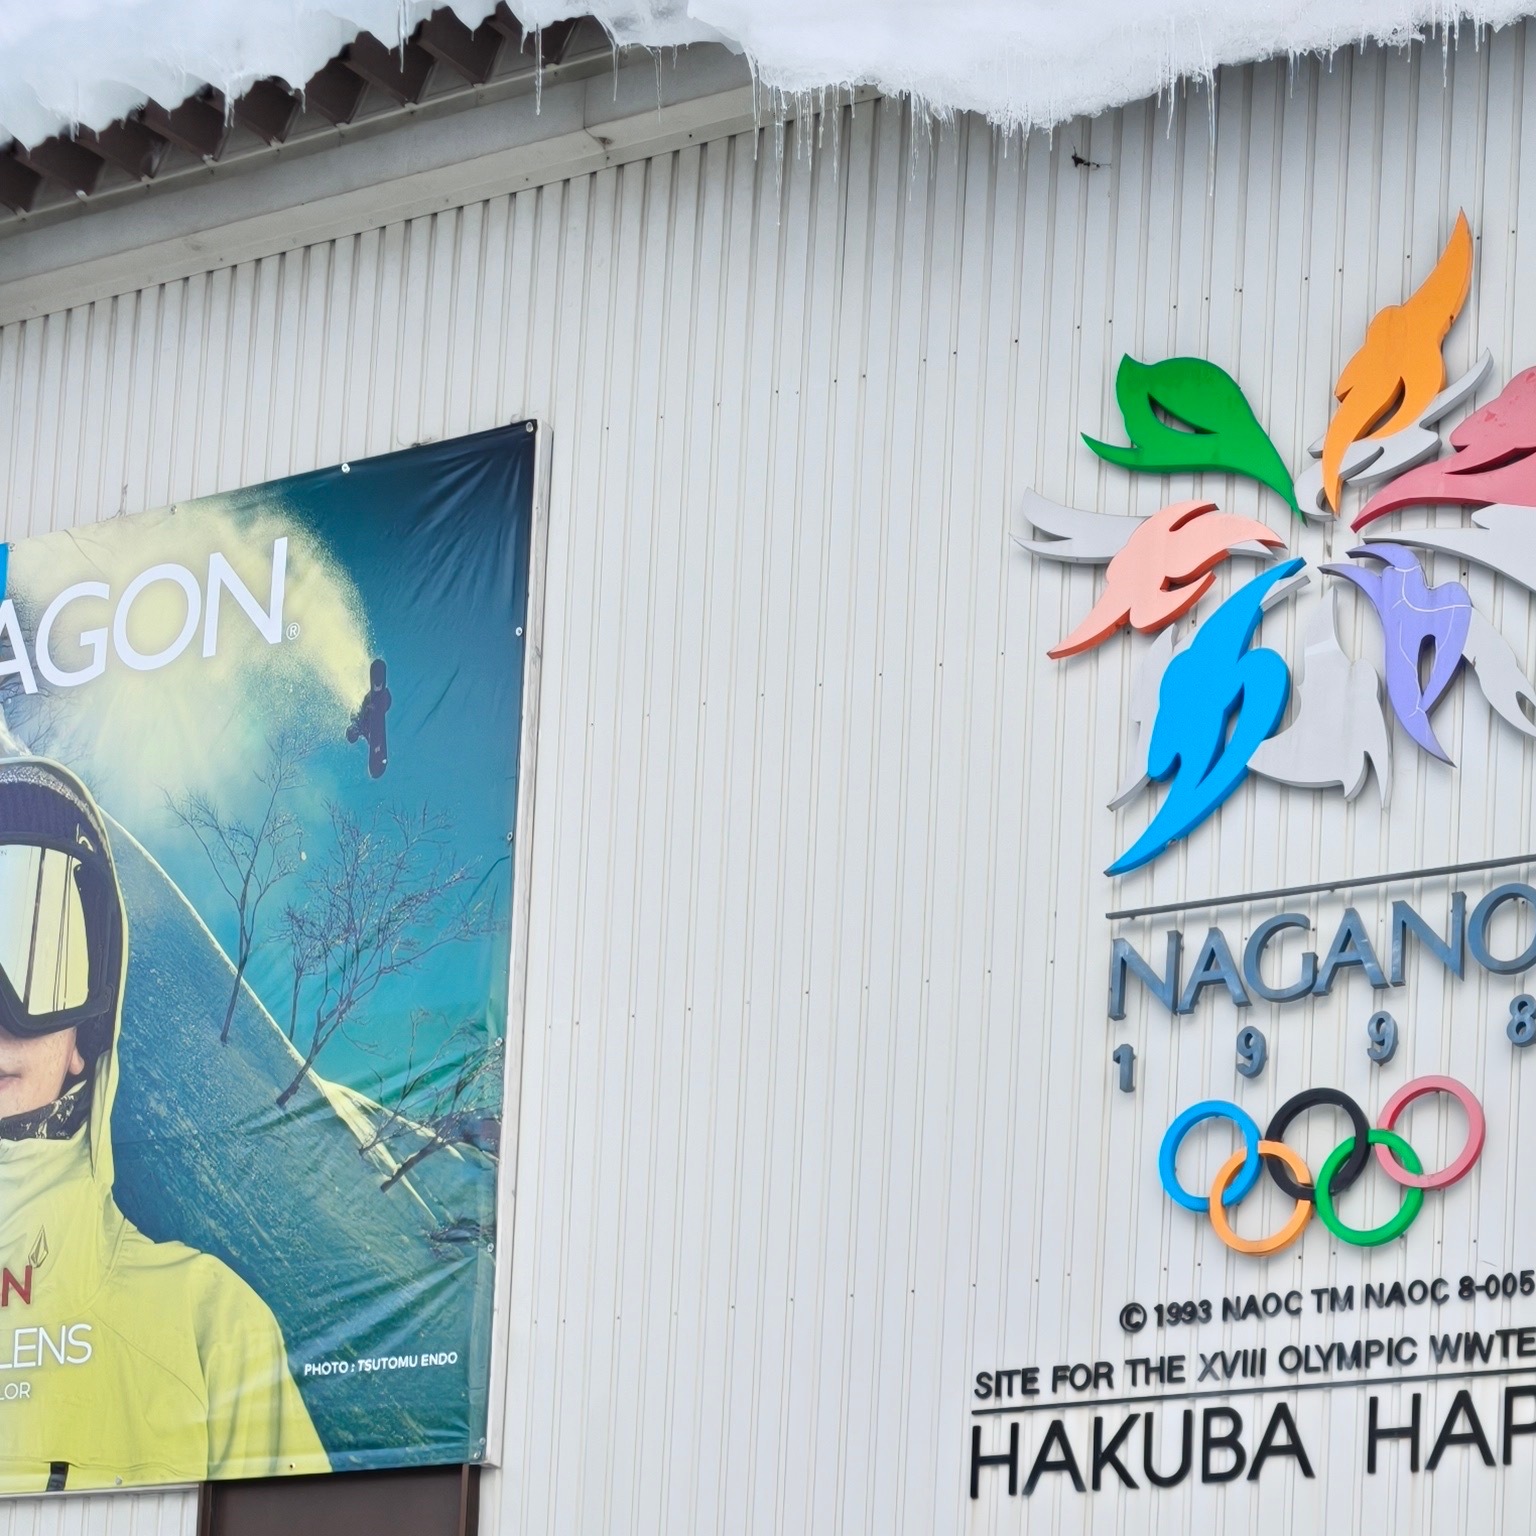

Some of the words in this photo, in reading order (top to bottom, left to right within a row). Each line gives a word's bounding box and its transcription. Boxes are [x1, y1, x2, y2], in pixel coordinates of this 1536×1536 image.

[1154, 1299, 1212, 1327] 1993
[1222, 1290, 1303, 1323] NAOC
[1311, 1285, 1354, 1314] TM
[1365, 1278, 1450, 1310] NAOC
[1458, 1270, 1536, 1301] 8-005
[357, 1354, 418, 1371] TSUTOMU
[420, 1351, 458, 1367] ENDO
[974, 1367, 1040, 1399] SITE
[1052, 1361, 1114, 1393] FOR
[1125, 1355, 1186, 1386] THE
[1198, 1348, 1266, 1382] XVIII
[1279, 1336, 1418, 1374] OLYMPIC
[970, 1402, 1316, 1499] HAKUBA
